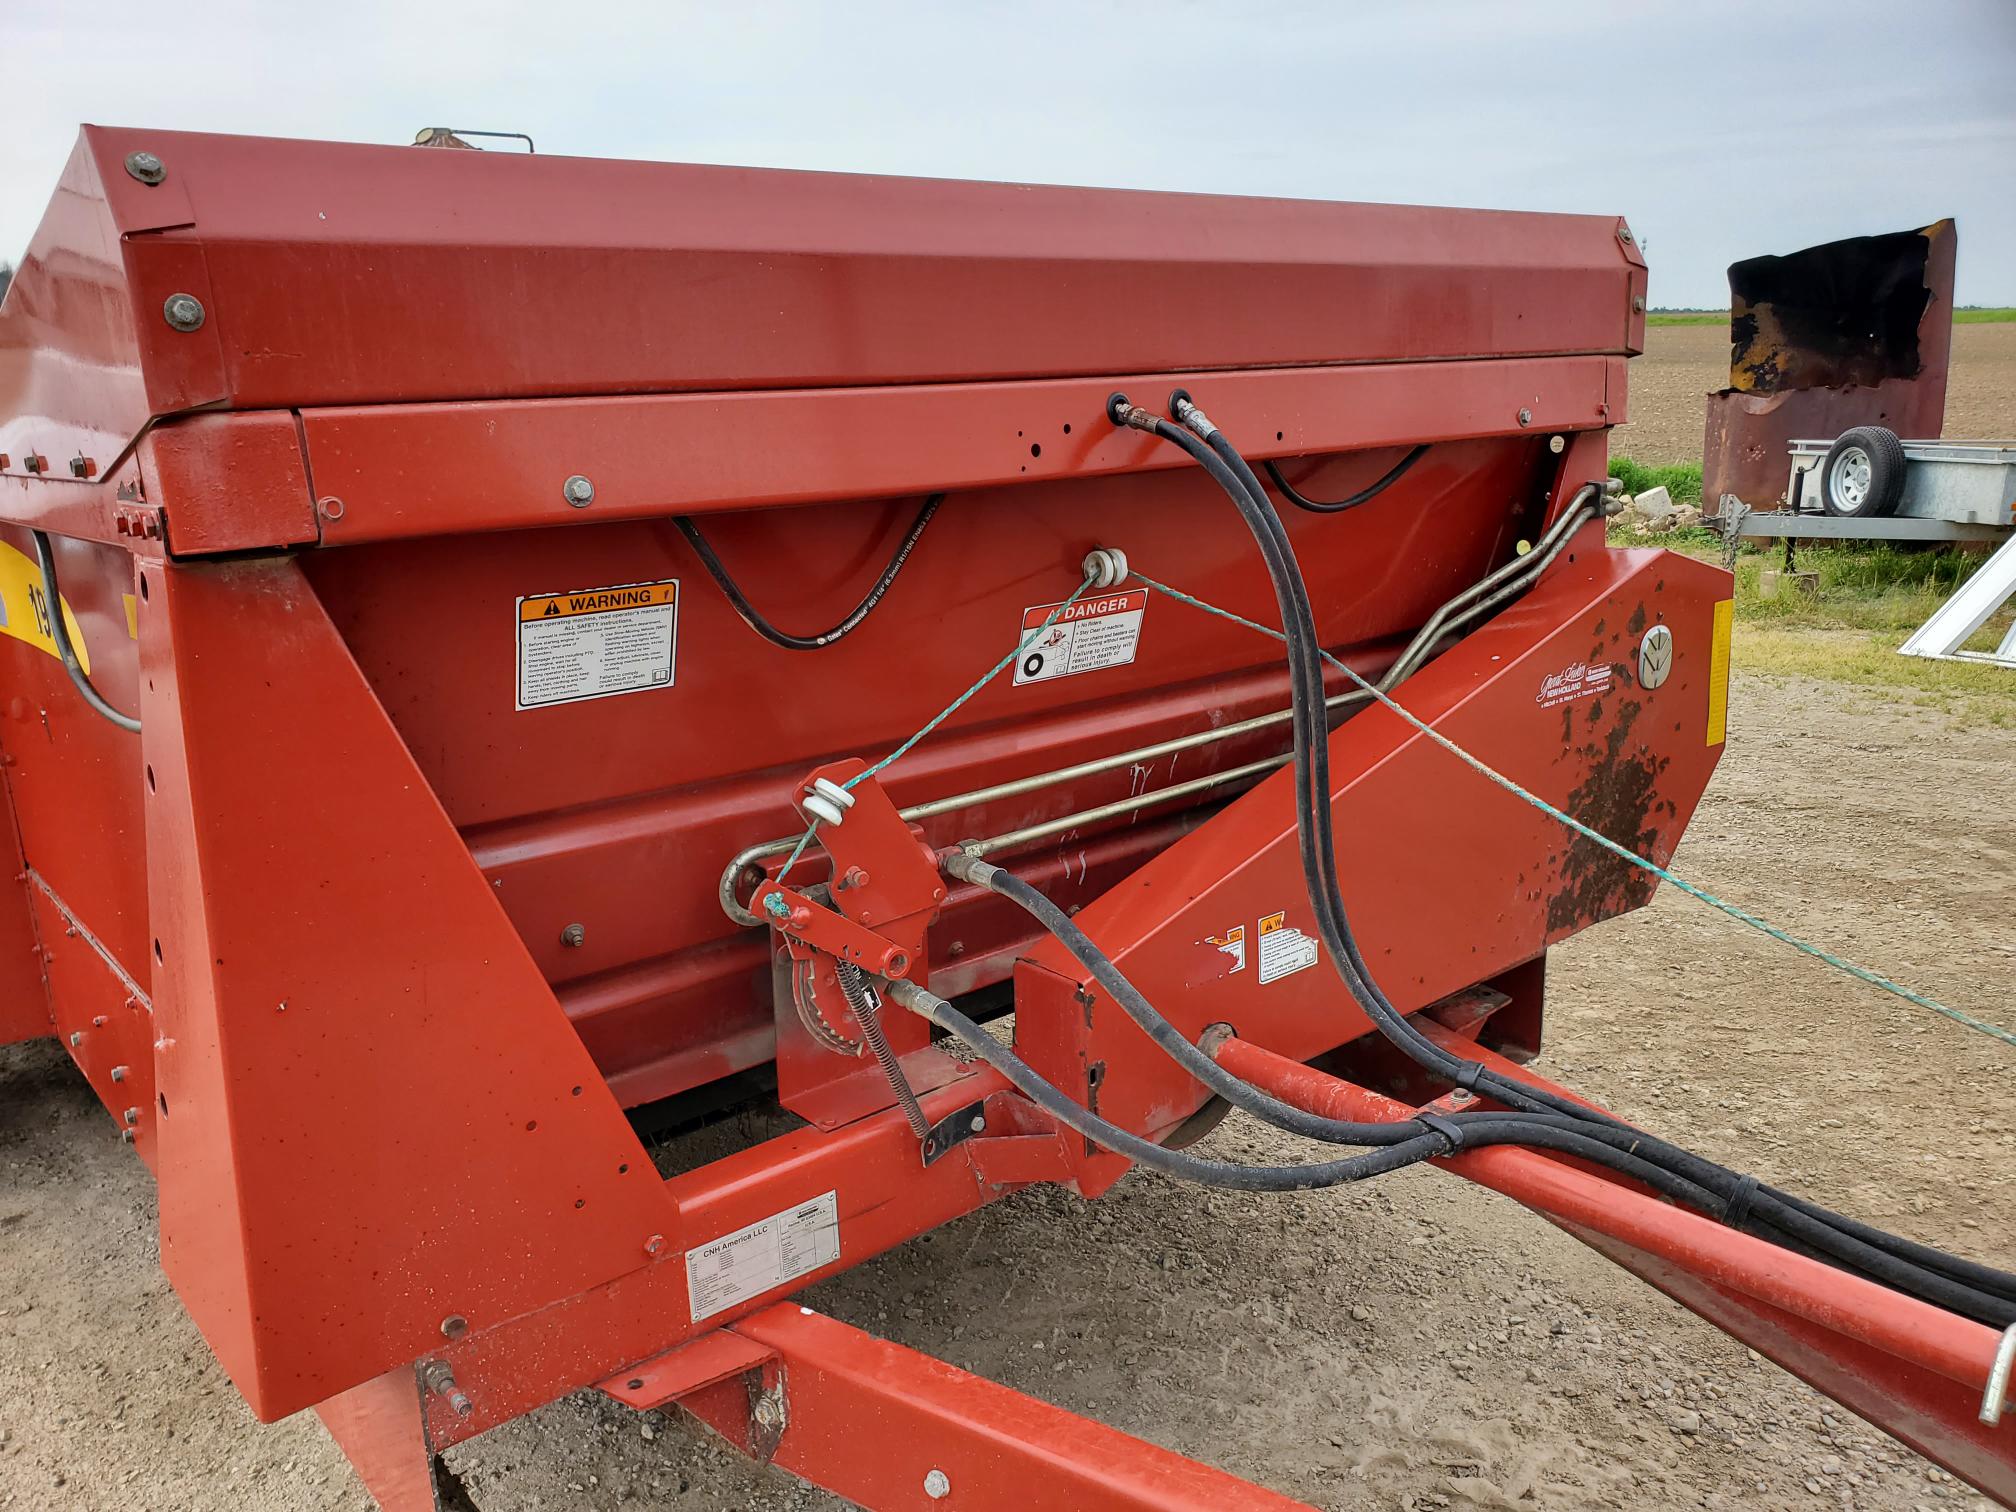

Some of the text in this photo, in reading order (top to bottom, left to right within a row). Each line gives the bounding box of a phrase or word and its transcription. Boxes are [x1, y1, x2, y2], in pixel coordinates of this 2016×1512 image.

[28, 583, 51, 638] 19
[570, 589, 651, 611] WARNING
[1064, 597, 1128, 619] DANGER
[545, 618, 572, 630] operating
[577, 621, 600, 630] SAFETY
[600, 618, 634, 627] instructions.
[1071, 662, 1092, 670] serious
[703, 1225, 768, 1258] CNH America LLC
